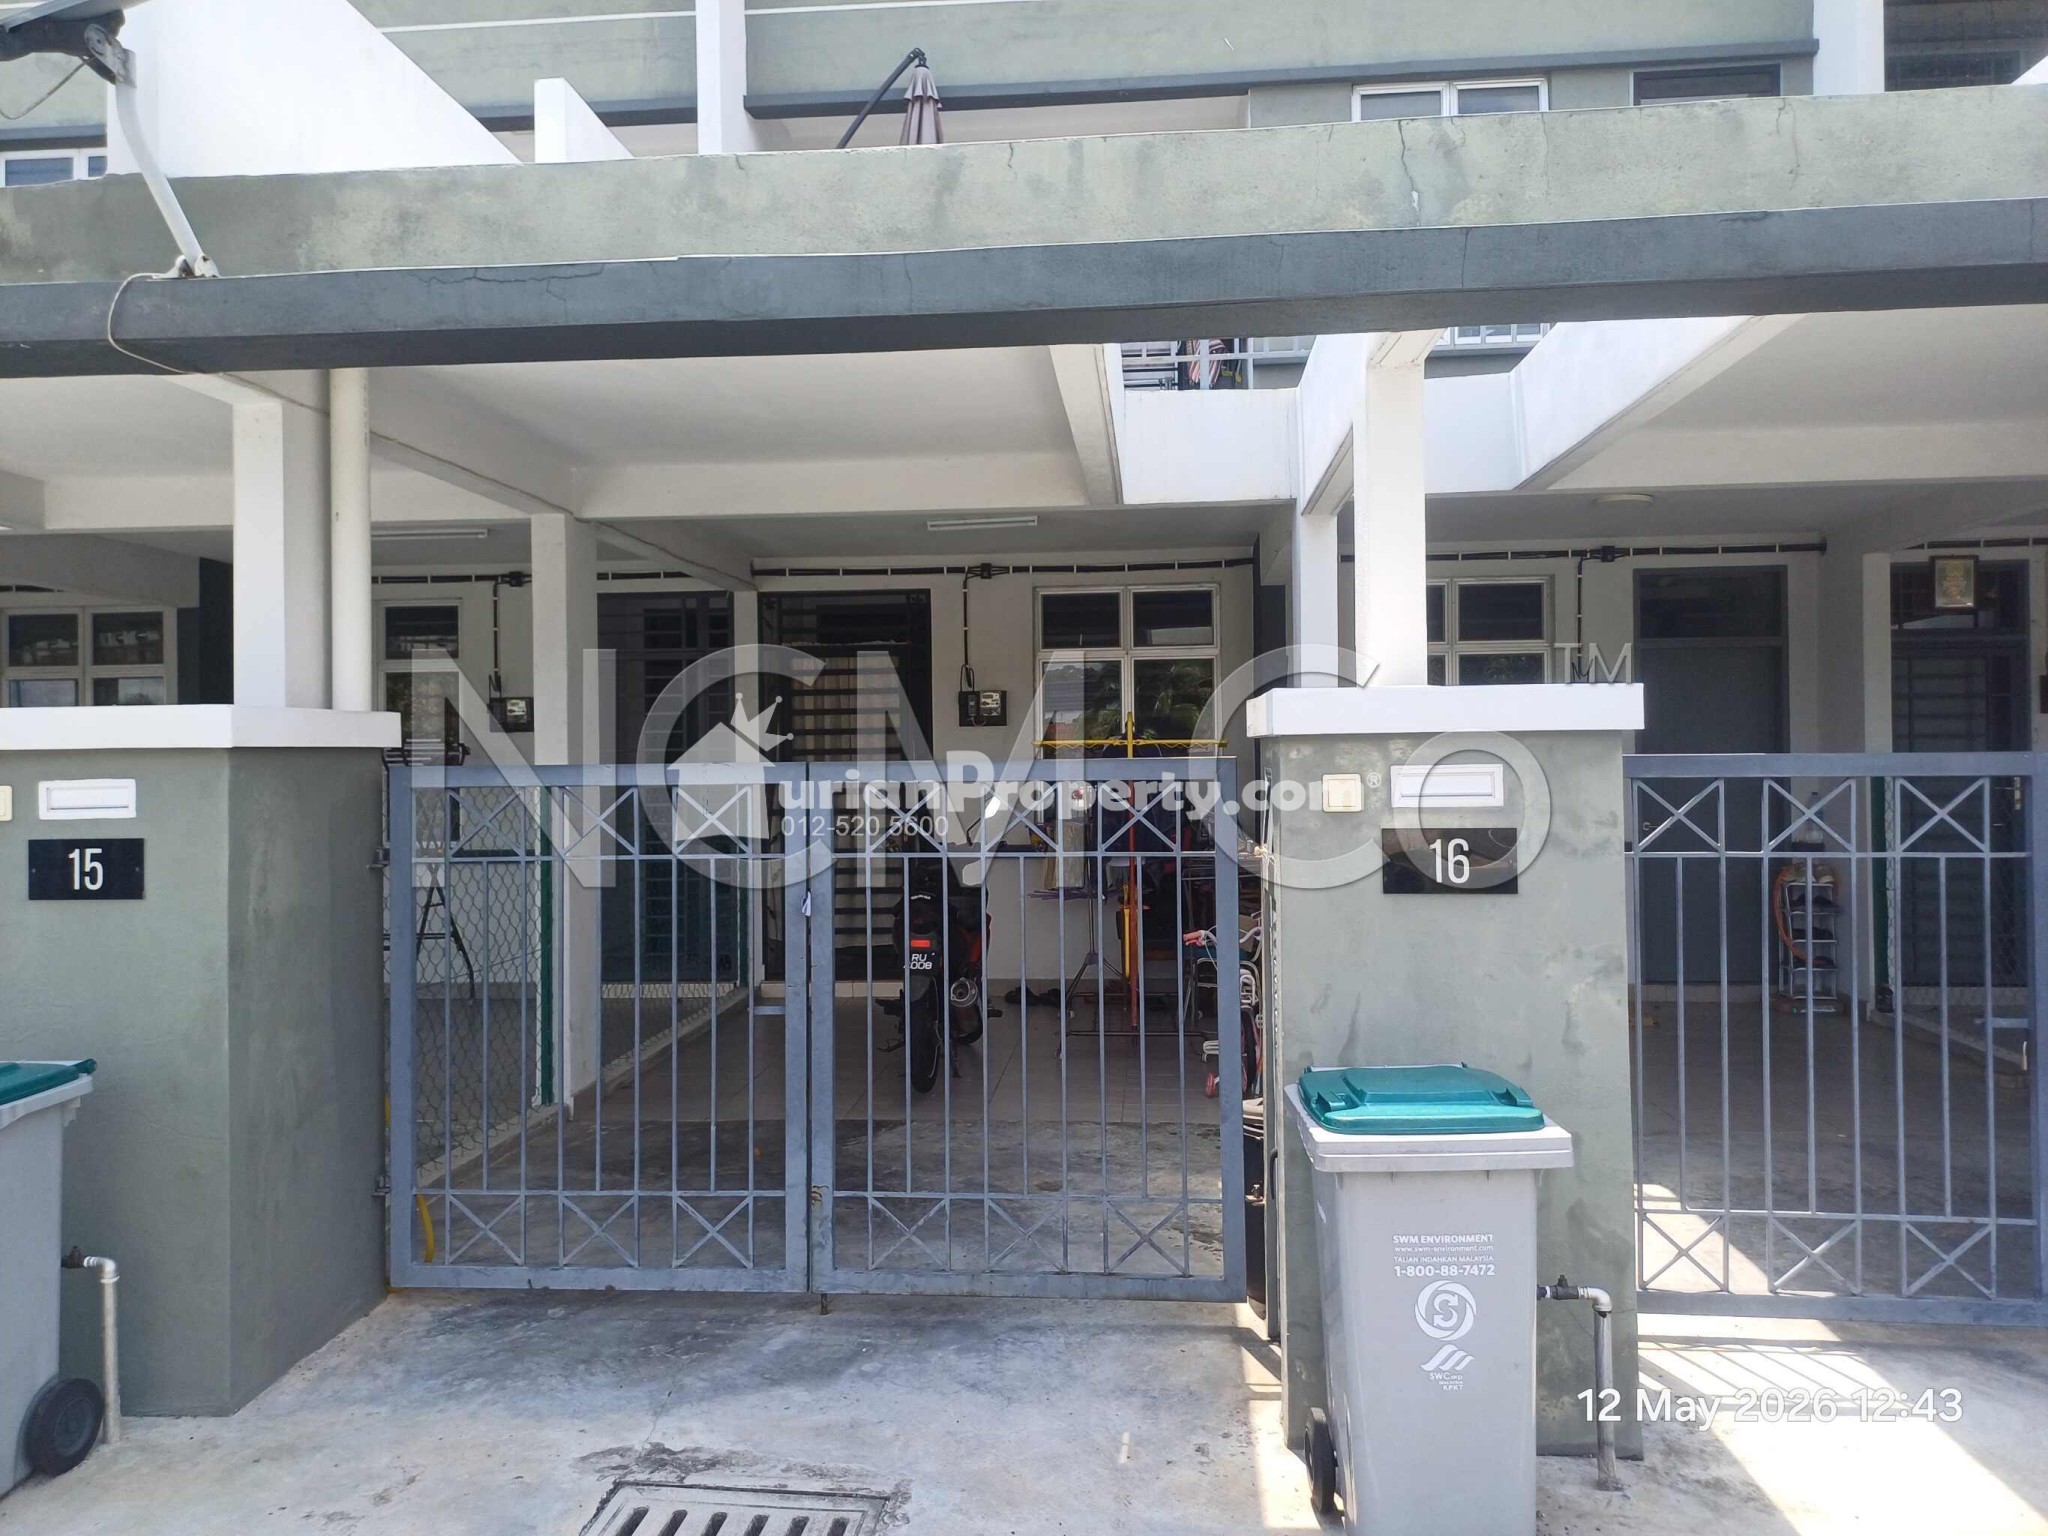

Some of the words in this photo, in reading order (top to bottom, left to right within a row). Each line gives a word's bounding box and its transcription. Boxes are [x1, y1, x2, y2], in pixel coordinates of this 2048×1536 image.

[1430, 838, 1471, 885] 16
[68, 848, 104, 891] 15
[911, 953, 928, 962] RU
[903, 961, 933, 970] 008
[1392, 1235, 1419, 1244] SWM
[1420, 1234, 1494, 1244] ENVIRONMENT
[1394, 1244, 1494, 1252] www.swm-environment.com
[1459, 1254, 1494, 1262] MALAYSIA
[1394, 1264, 1496, 1277] 1-800-88-7472
